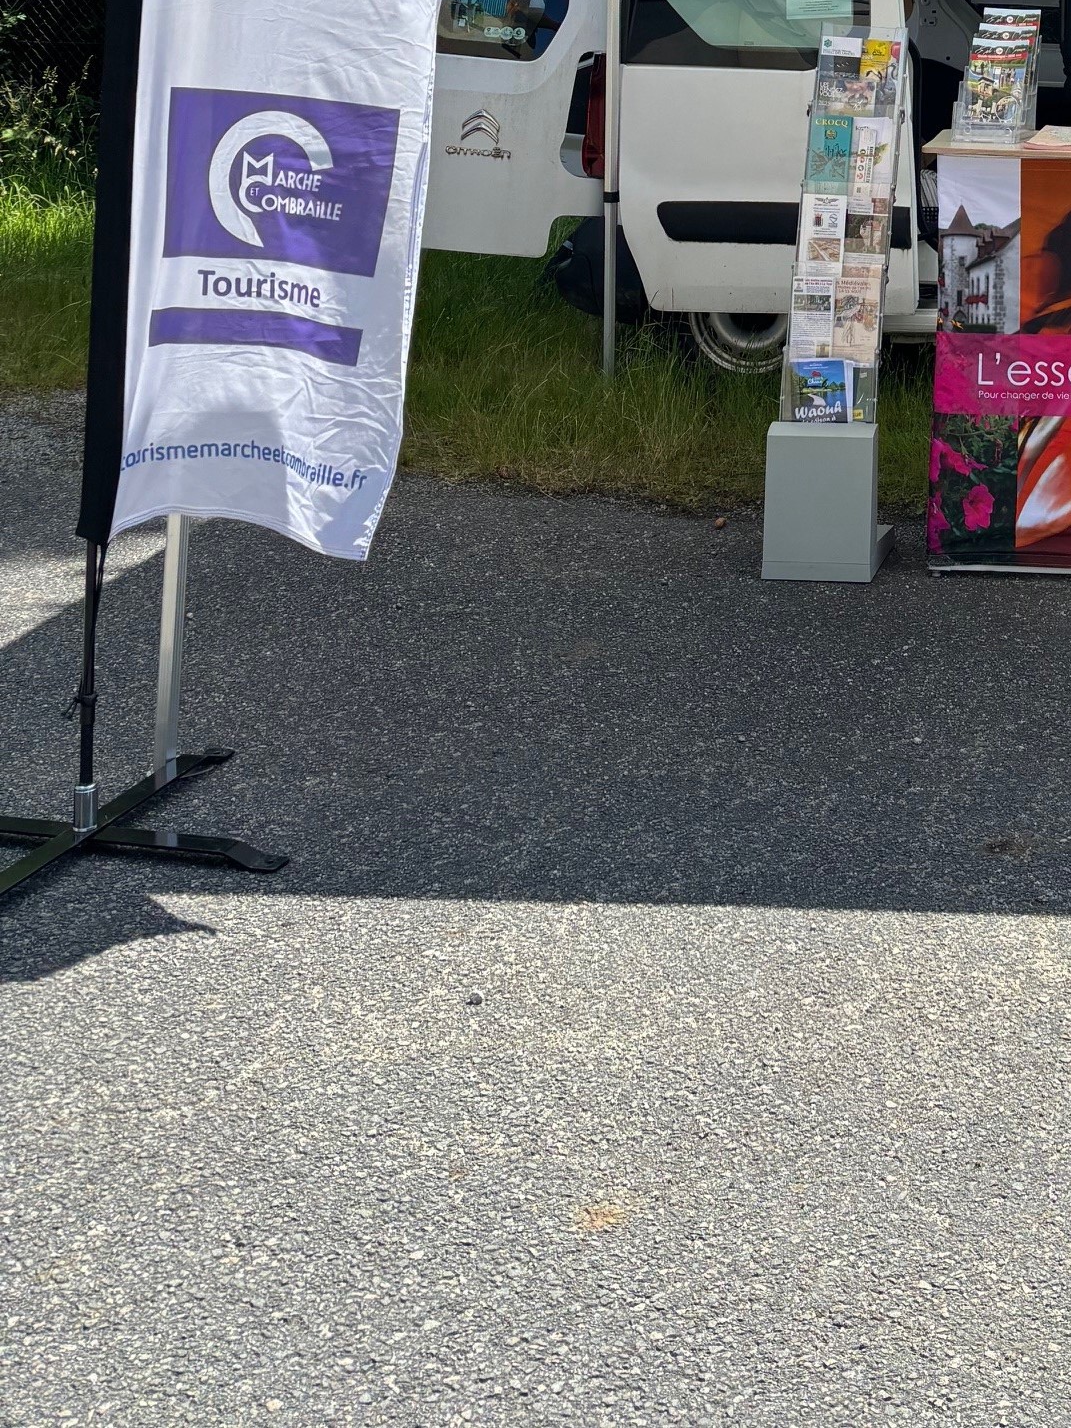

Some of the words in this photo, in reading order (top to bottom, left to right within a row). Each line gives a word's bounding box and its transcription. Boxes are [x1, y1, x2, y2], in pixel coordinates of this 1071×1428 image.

[815, 118, 849, 128] CROCQ
[241, 150, 322, 192] MARCHE
[249, 187, 260, 197] ET
[197, 269, 321, 308] Tourisme
[978, 390, 999, 400] Pour
[1000, 390, 1040, 401] changer
[1041, 391, 1054, 400] de
[1056, 391, 1070, 400] vie
[794, 401, 842, 420] Waouh
[120, 440, 368, 490] ourismemarcheetcombraille.fr
